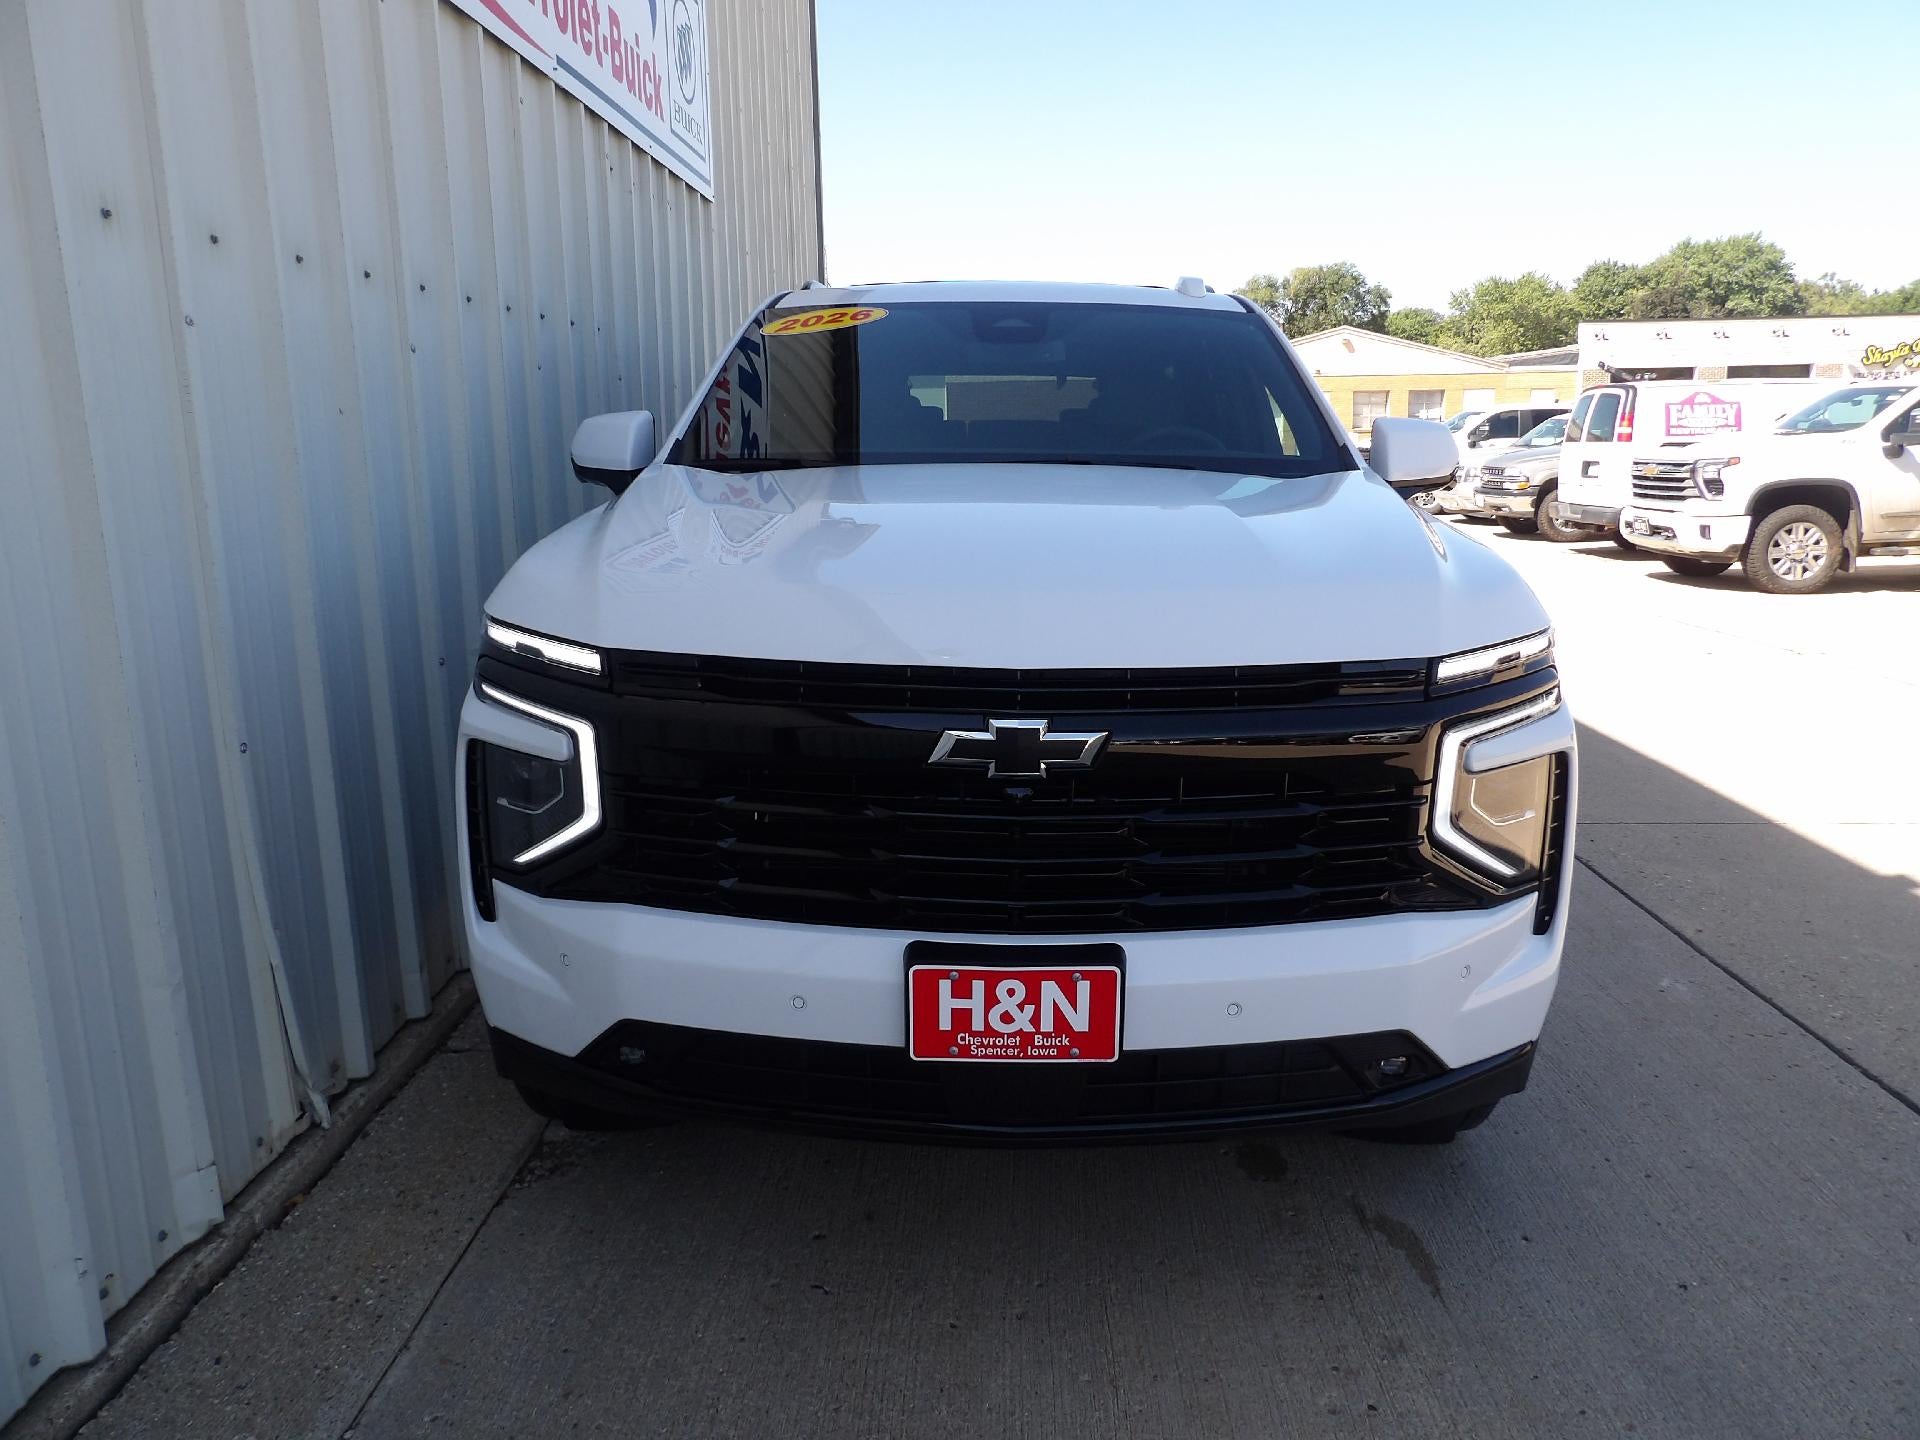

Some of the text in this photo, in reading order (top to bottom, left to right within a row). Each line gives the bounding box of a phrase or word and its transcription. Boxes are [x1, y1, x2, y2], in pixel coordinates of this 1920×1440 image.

[673, 99, 703, 145] BUICK
[774, 309, 875, 333] 2026
[938, 978, 1091, 1033] H&N
[957, 1033, 1070, 1046] Chevrolet Buick
[970, 1045, 1057, 1057] Spencer, Iowa
